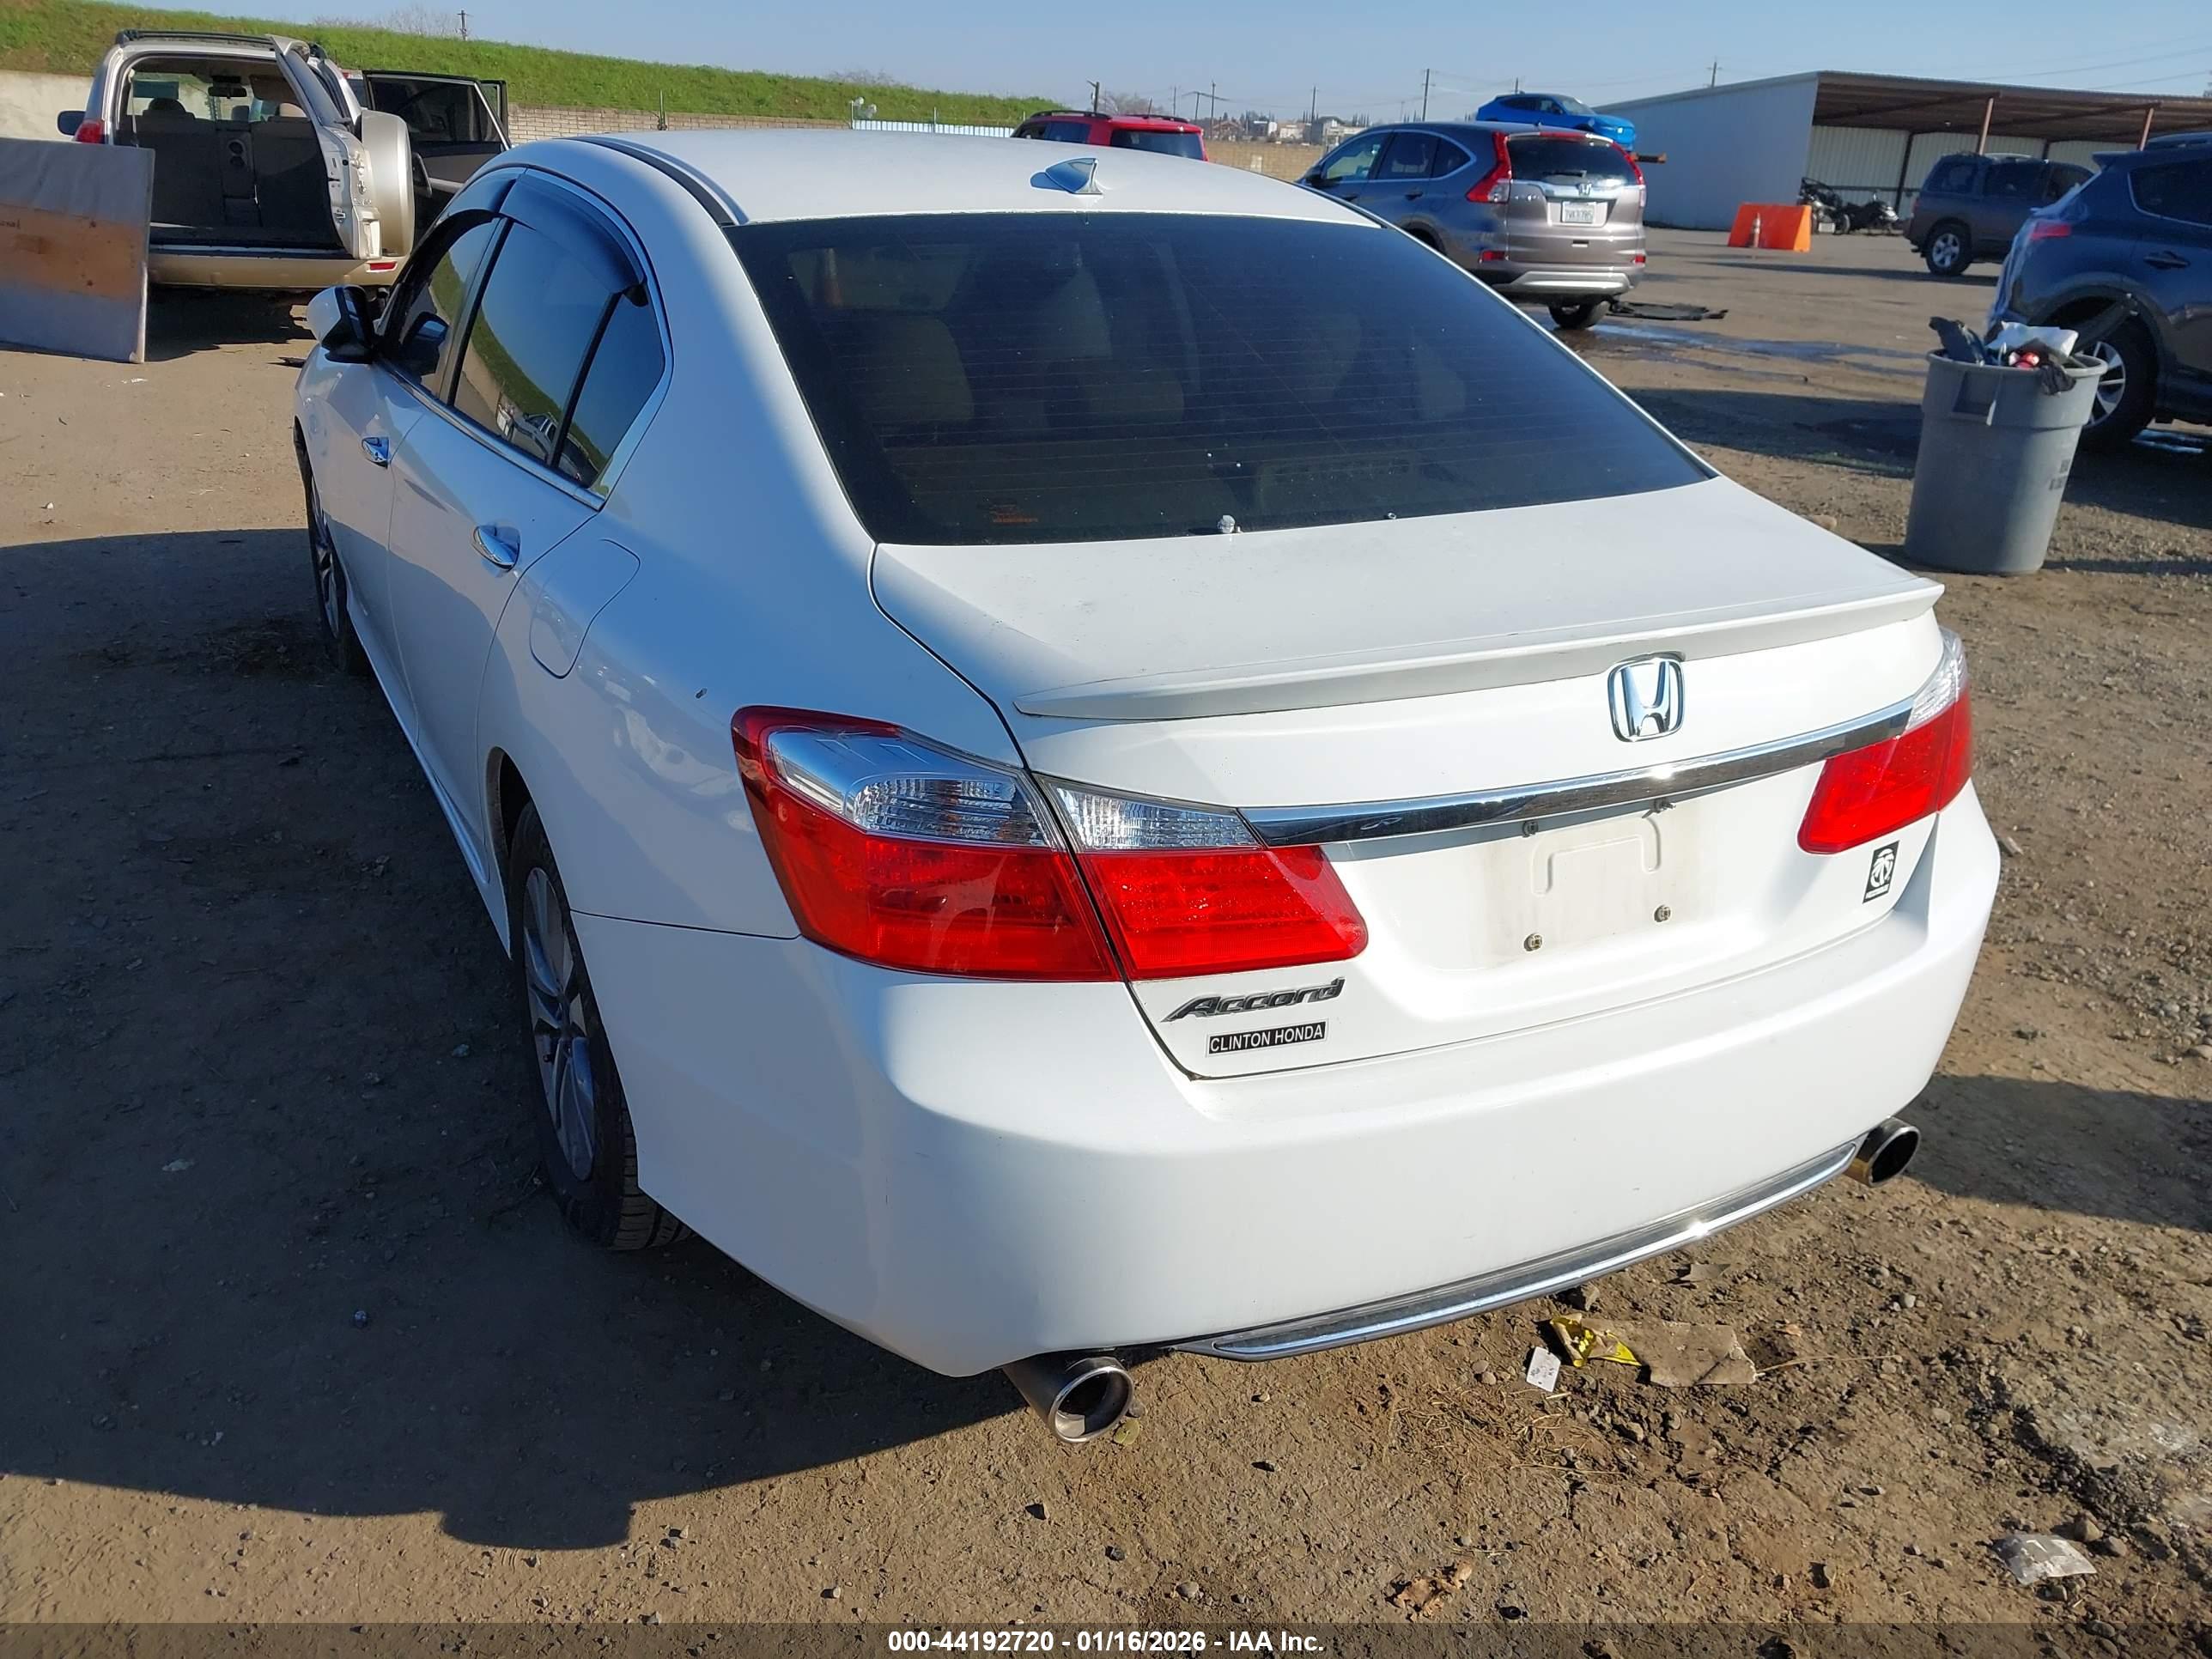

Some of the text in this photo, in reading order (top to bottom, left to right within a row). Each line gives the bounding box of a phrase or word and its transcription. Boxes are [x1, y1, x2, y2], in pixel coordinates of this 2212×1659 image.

[1160, 976, 1346, 1023] Accord
[1209, 1024, 1323, 1053] CLINTON HONDA
